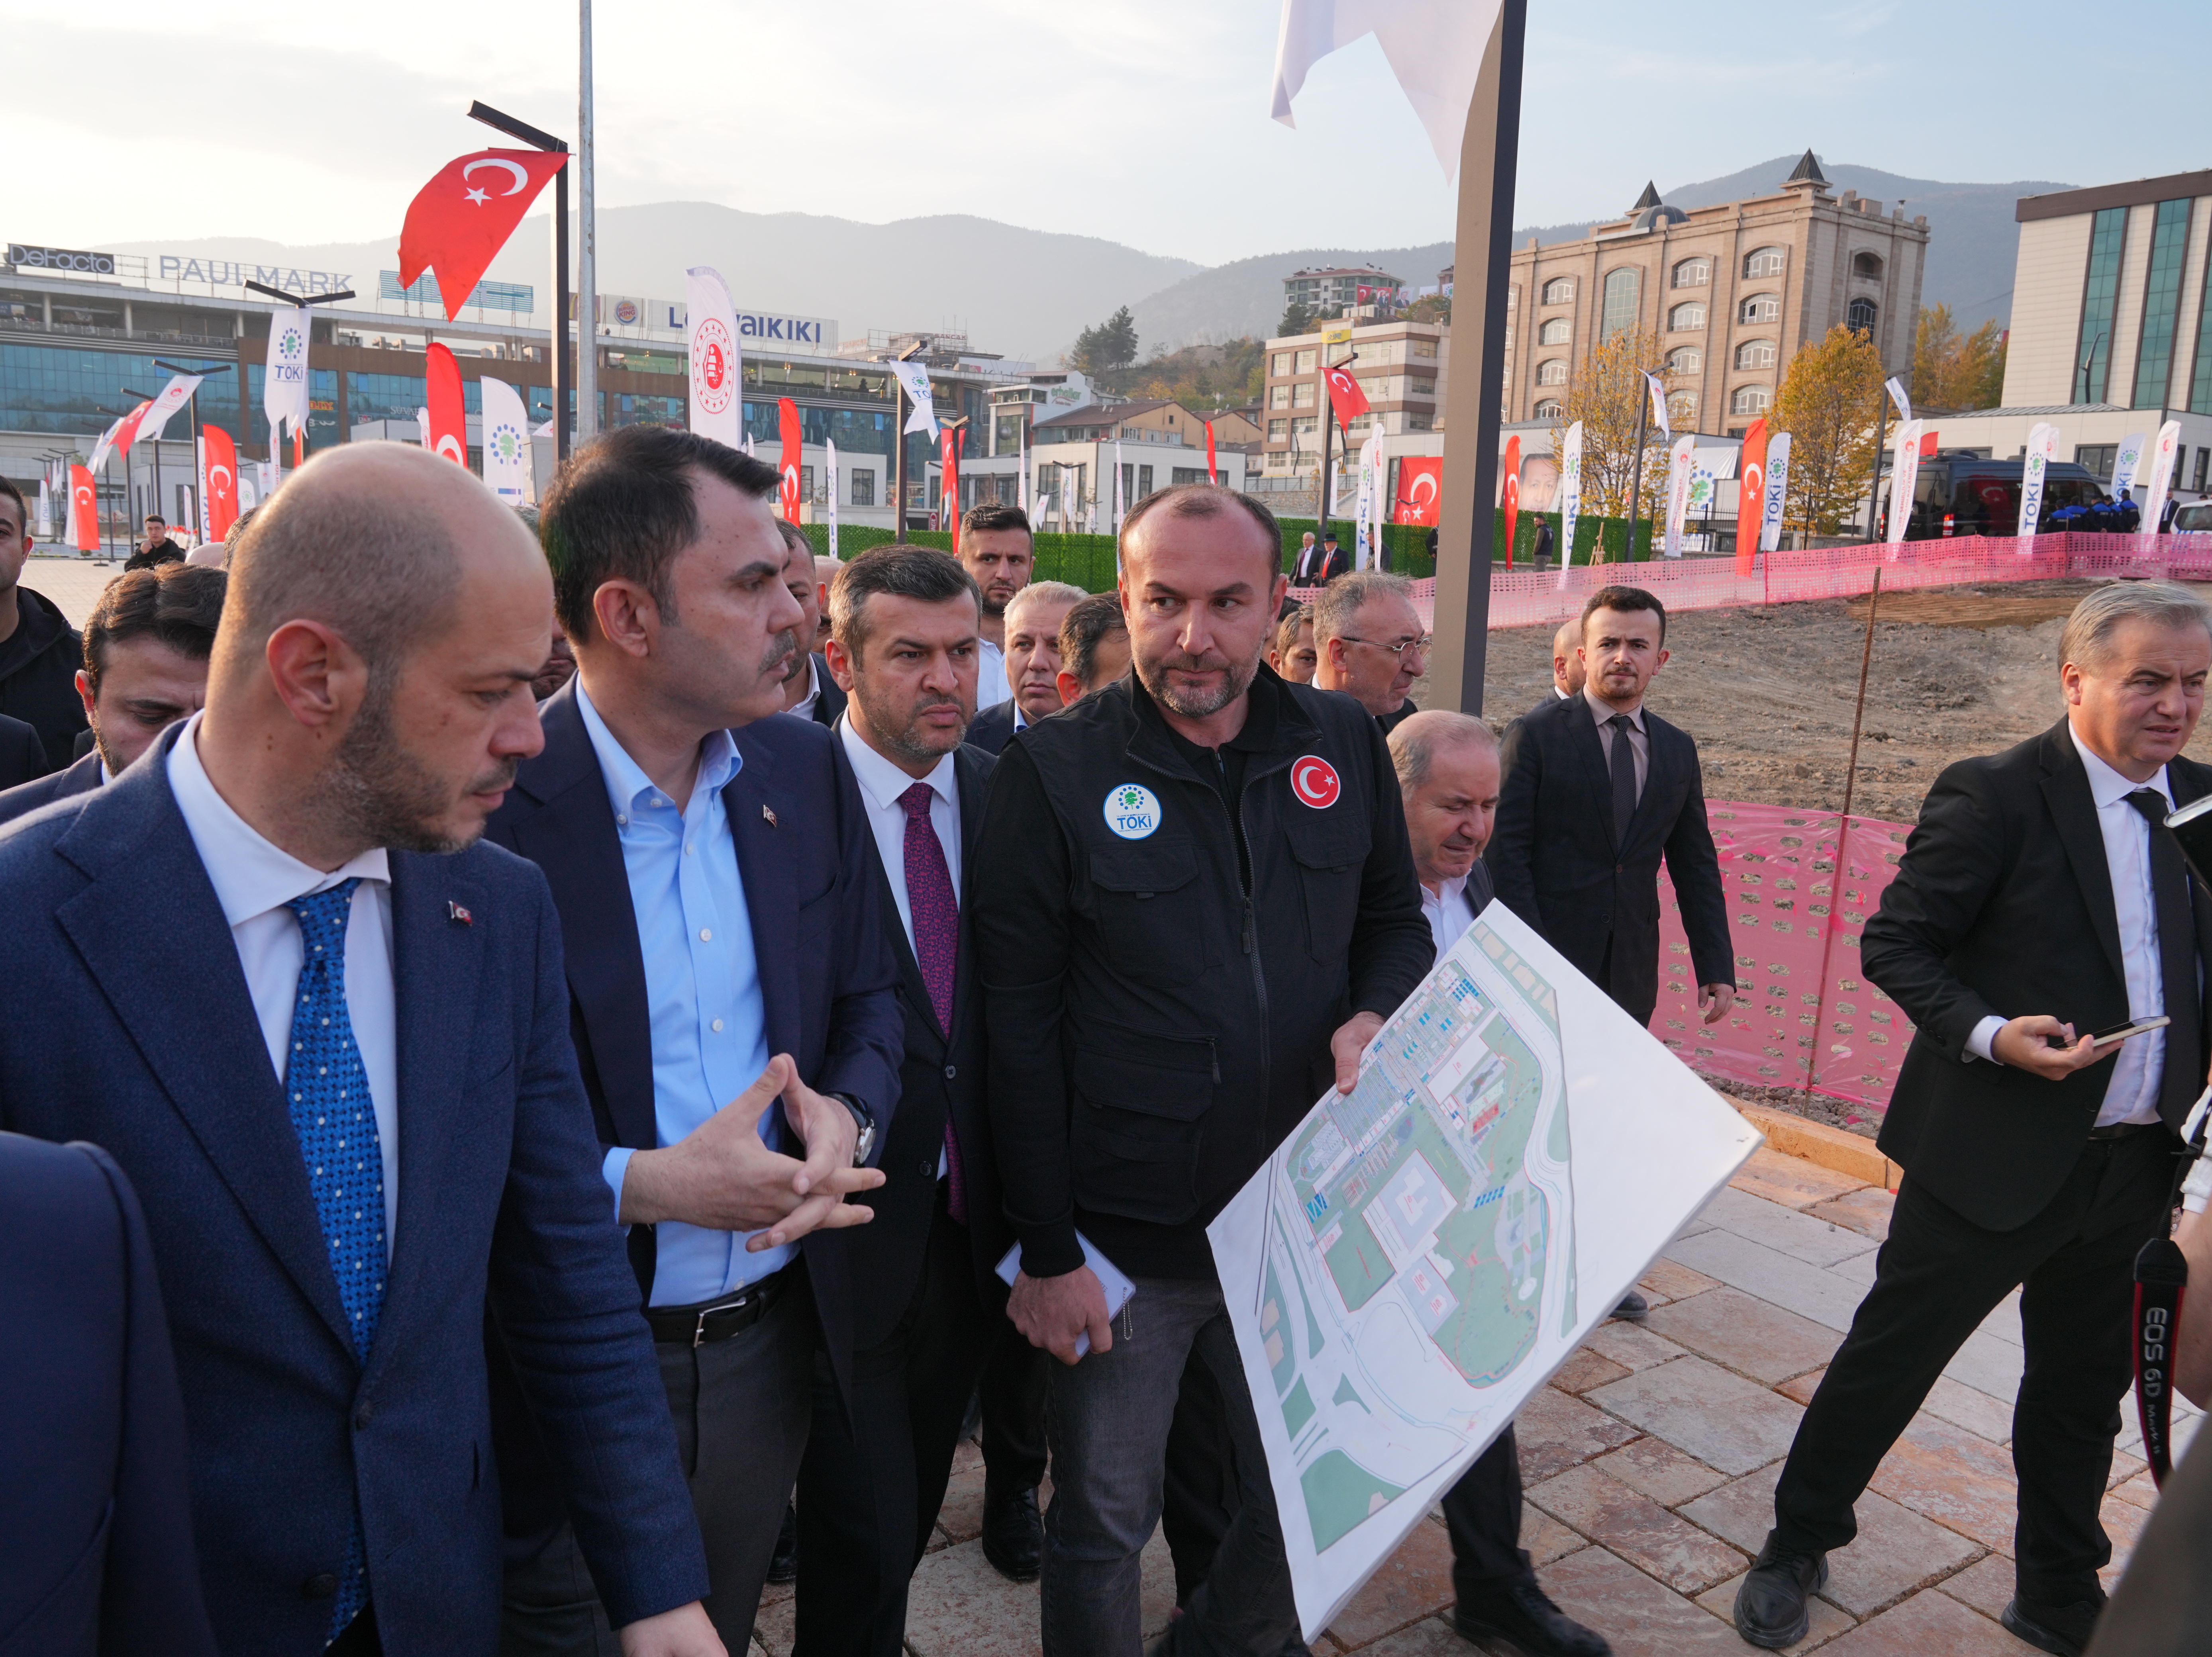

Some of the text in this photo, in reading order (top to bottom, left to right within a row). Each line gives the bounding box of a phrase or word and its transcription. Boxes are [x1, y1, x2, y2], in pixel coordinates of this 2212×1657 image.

[10, 244, 113, 273] DeFacto
[160, 255, 353, 294] PAUL MARK
[669, 307, 688, 328] L
[2144, 1307, 2168, 1361] EOS
[2144, 1368, 2162, 1397] 6D
